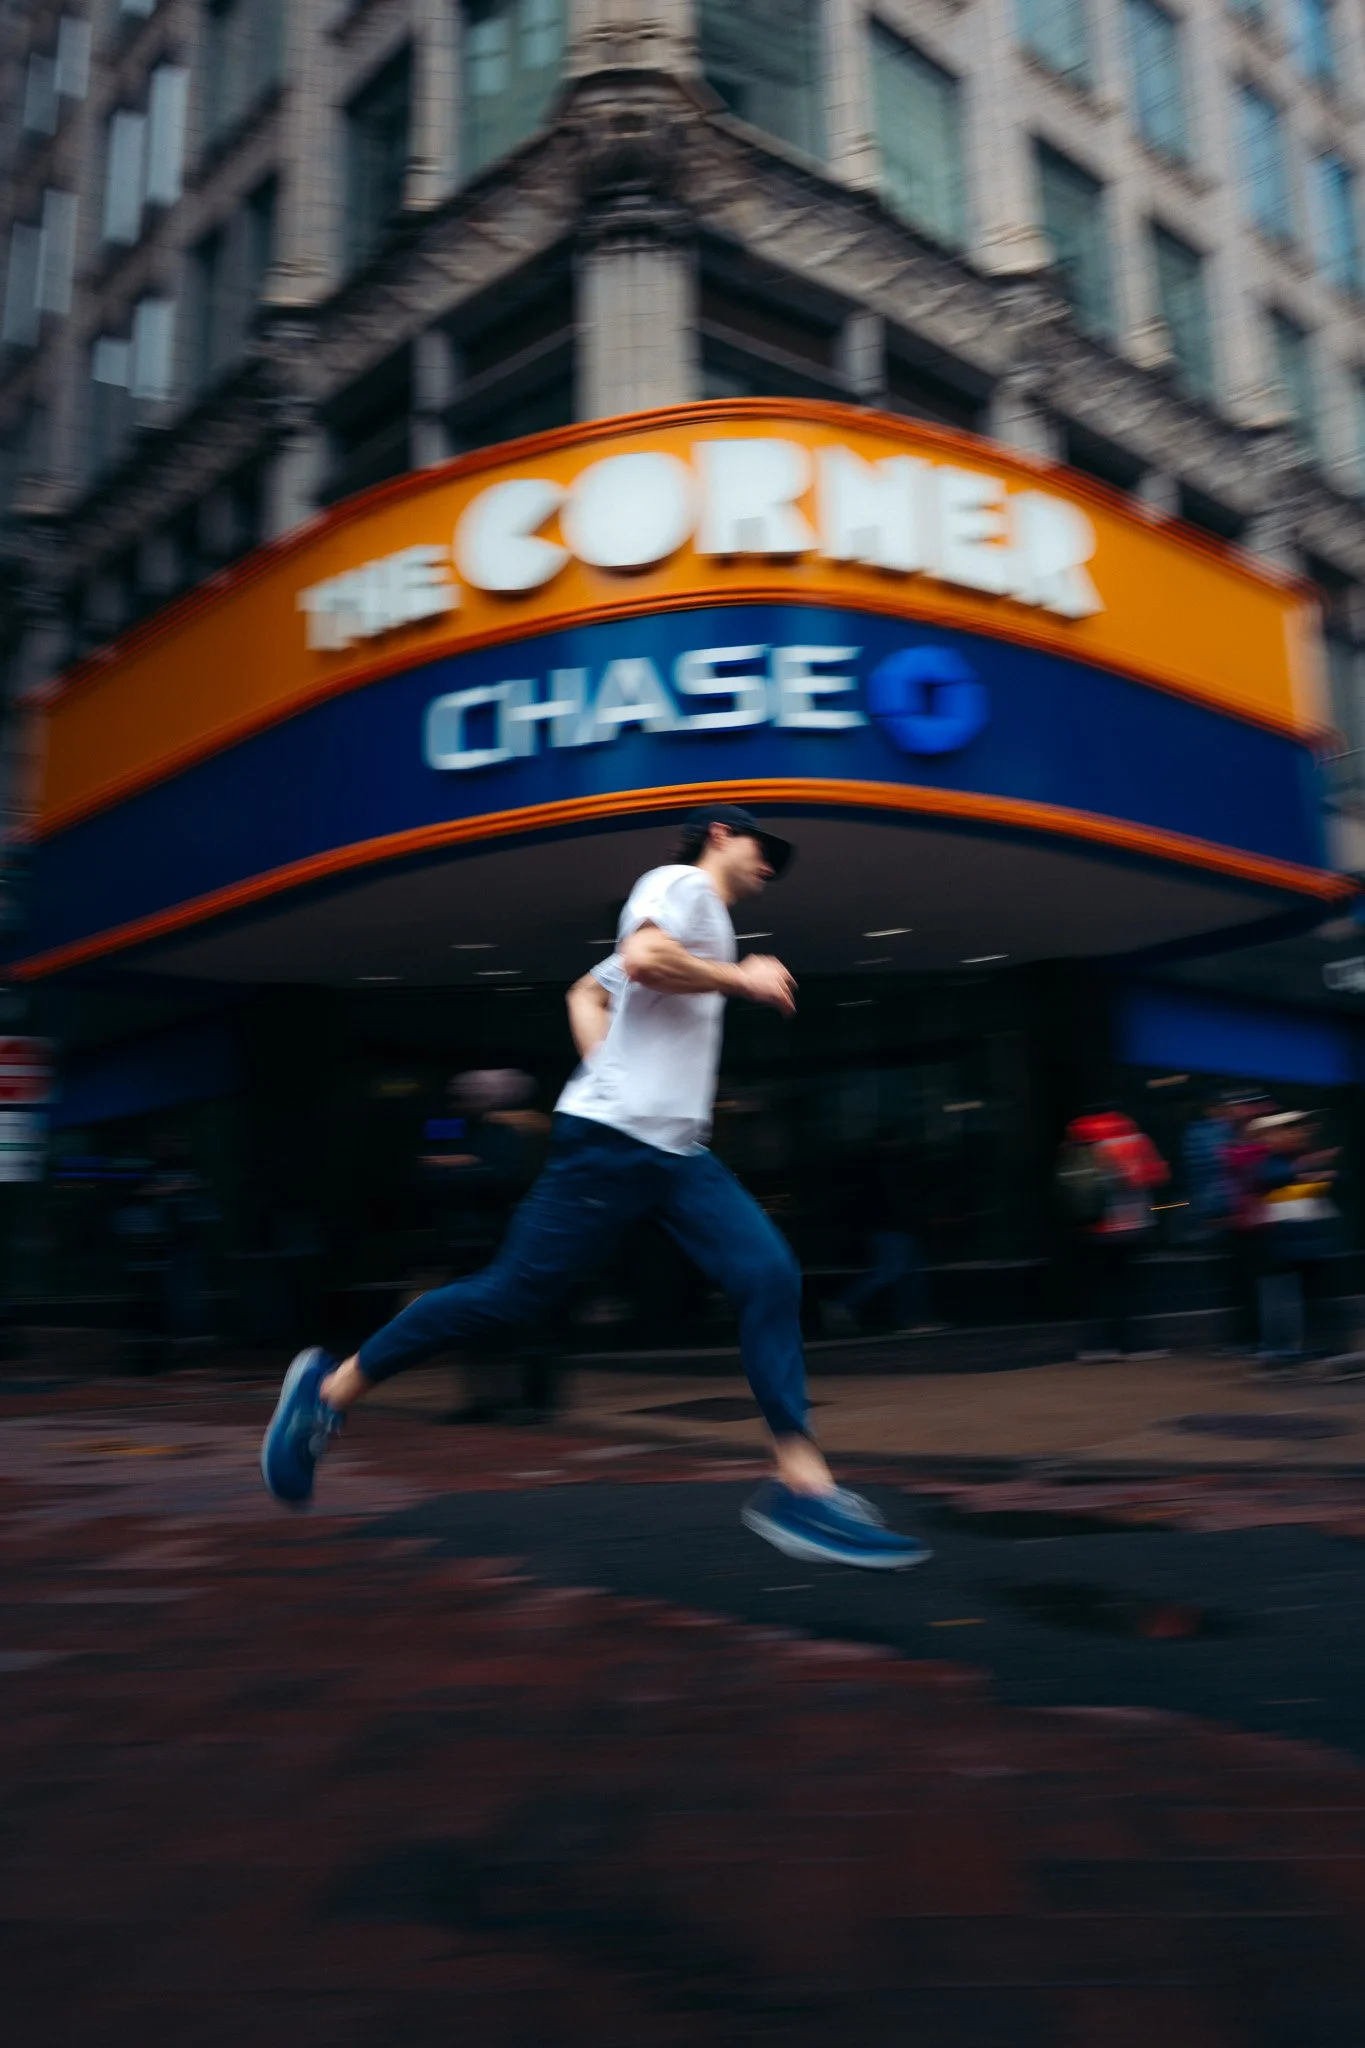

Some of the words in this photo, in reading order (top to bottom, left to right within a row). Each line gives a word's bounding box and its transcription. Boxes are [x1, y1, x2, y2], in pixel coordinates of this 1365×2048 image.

[301, 544, 458, 651] THE
[456, 437, 1103, 618] CORNER
[422, 643, 867, 771] CHASE
